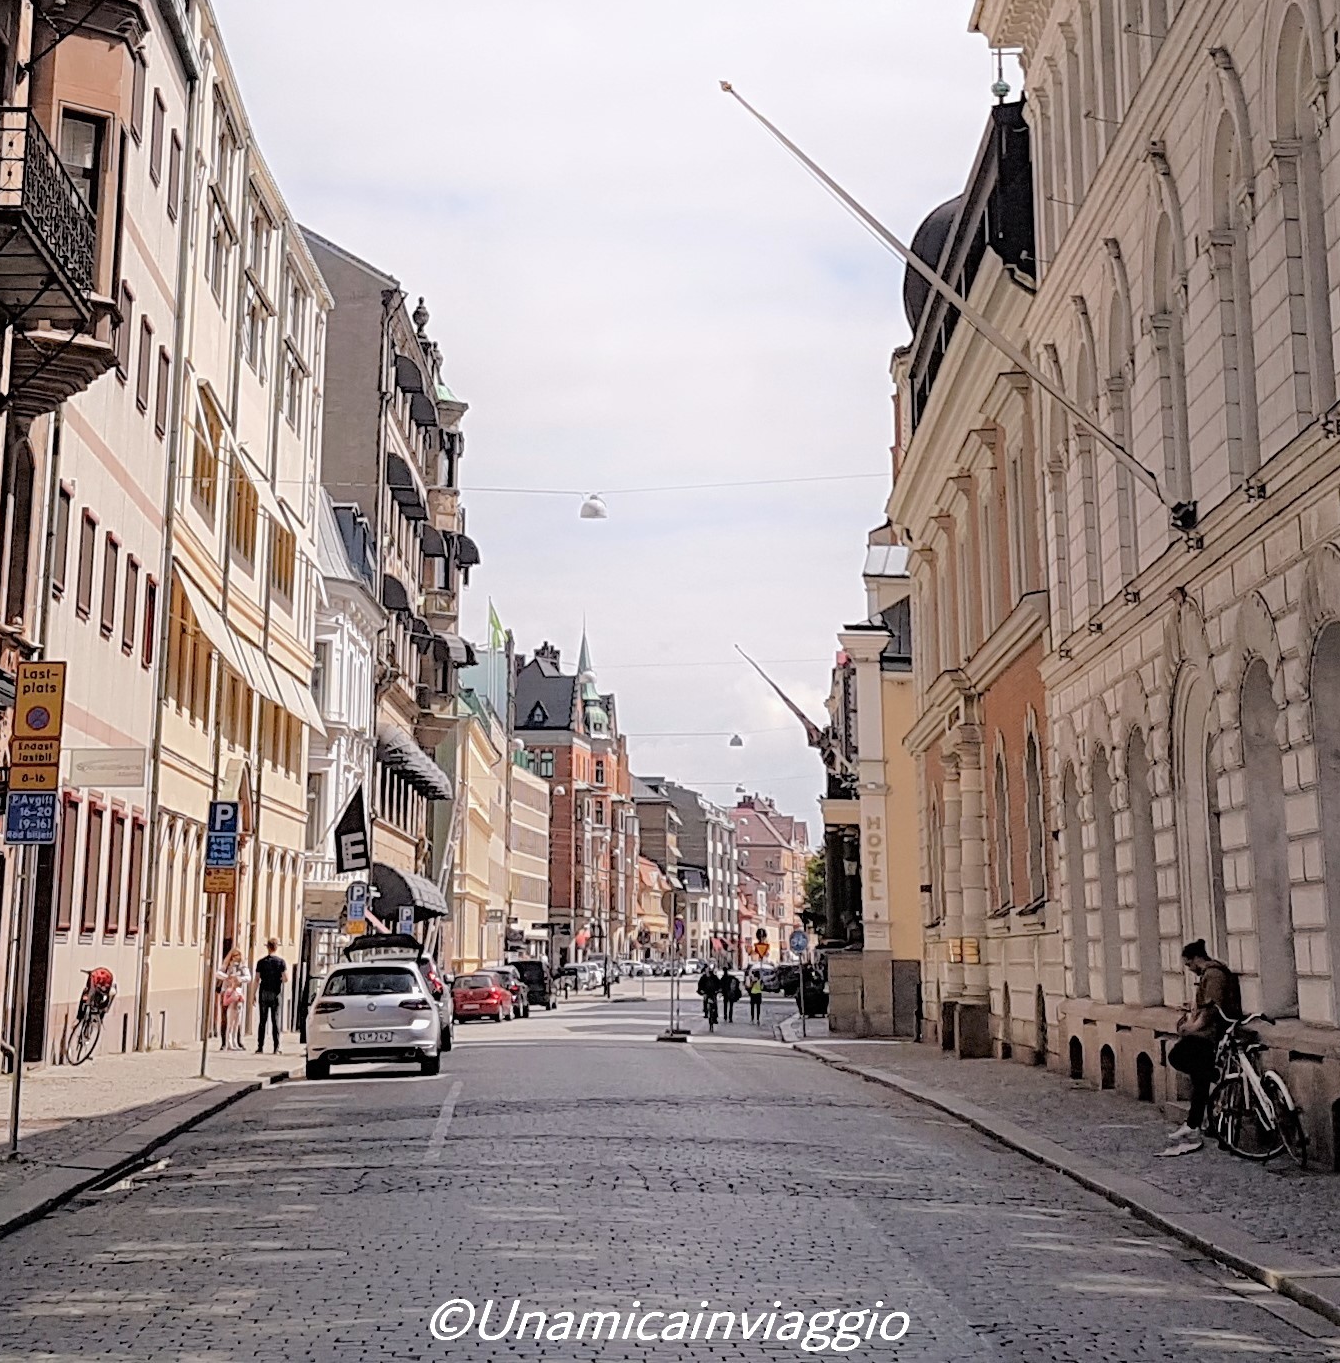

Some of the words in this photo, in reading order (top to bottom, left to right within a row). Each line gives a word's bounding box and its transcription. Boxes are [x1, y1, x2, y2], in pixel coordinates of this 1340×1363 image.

[23, 668, 59, 679] Last-
[23, 682, 57, 695] plats
[18, 742, 53, 750] Endast
[21, 774, 46, 782] 8-16
[20, 807, 52, 817] 16-20
[214, 803, 234, 831] P
[866, 815, 883, 902] HOTEL
[353, 886, 364, 901] P
[402, 908, 412, 921] P
